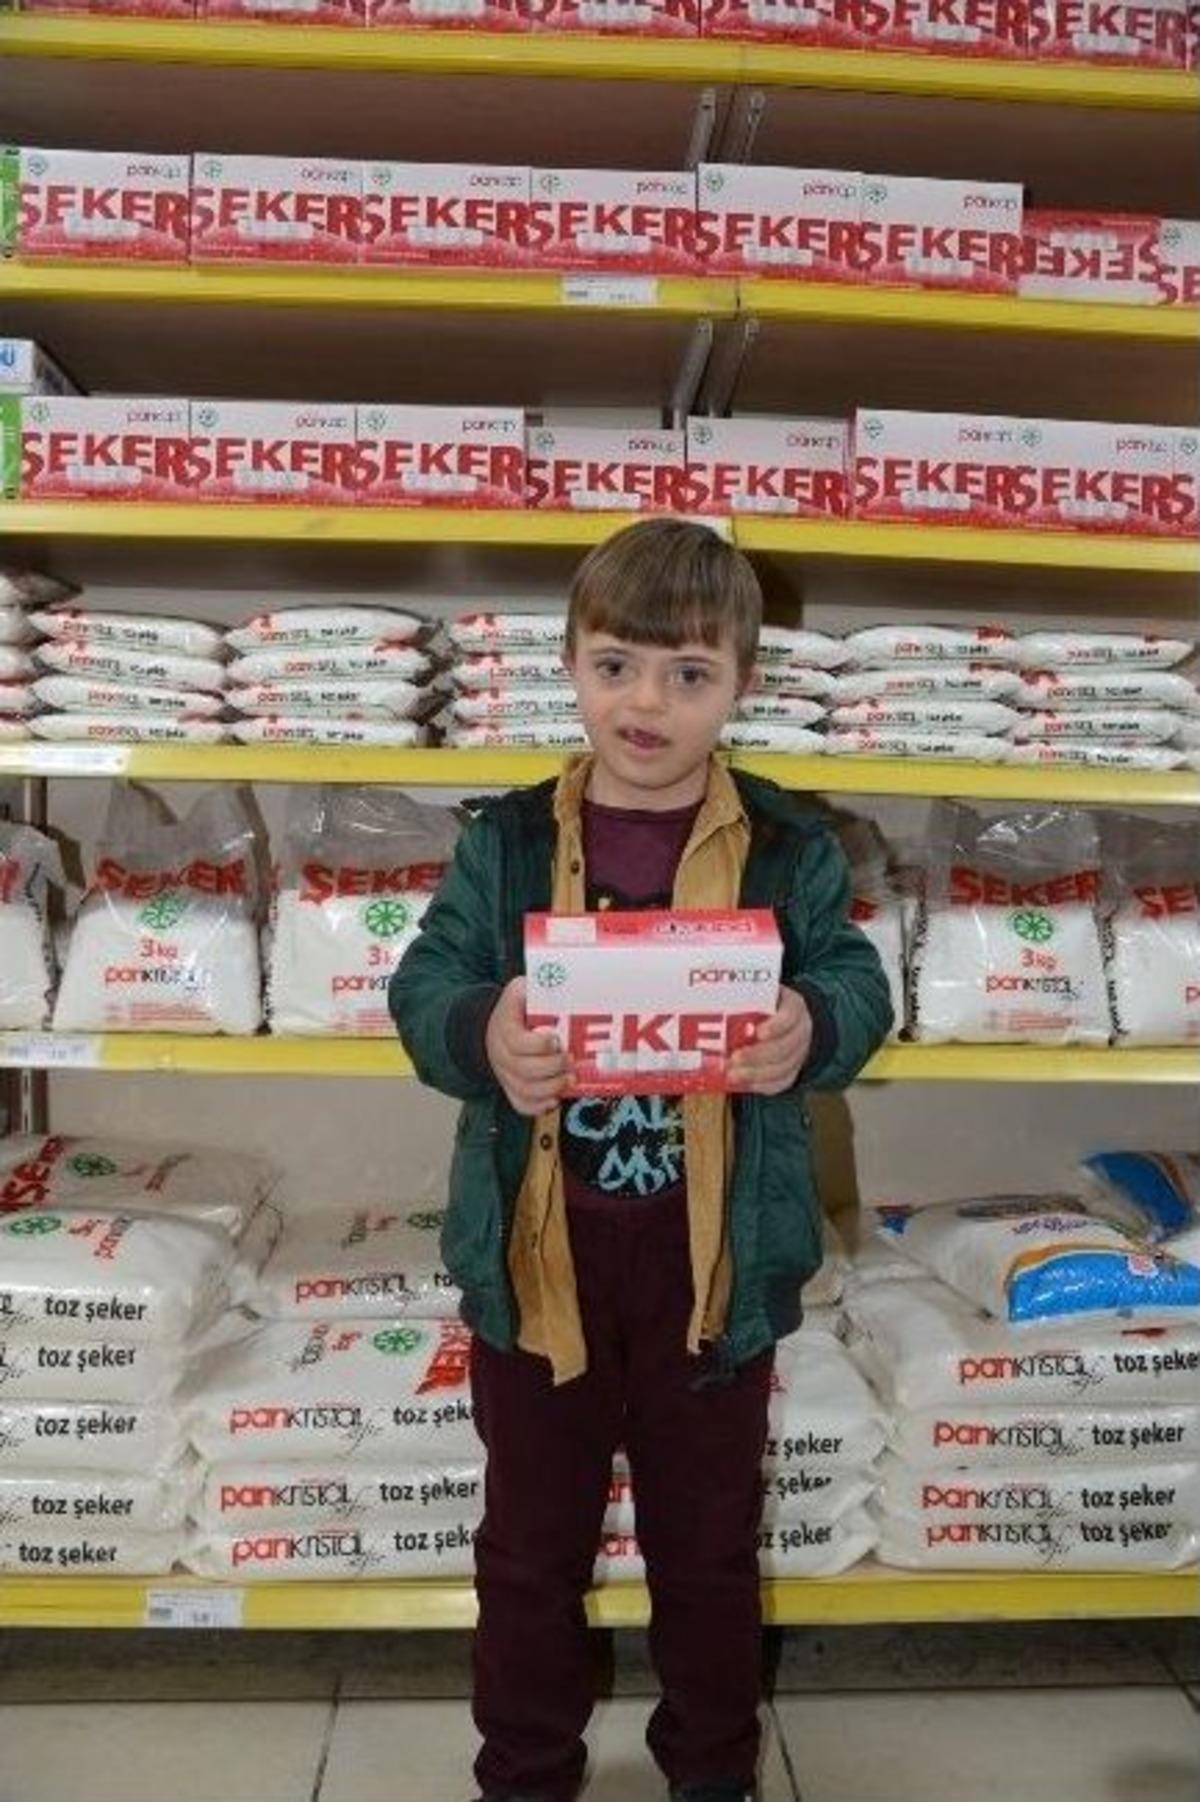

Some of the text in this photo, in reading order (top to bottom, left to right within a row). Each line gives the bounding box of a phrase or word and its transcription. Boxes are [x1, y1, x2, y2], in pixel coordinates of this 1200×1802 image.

[44, 1295, 147, 1322] toz şeker
[38, 1344, 136, 1373] toz şeker
[1114, 1352, 1148, 1374] toz
[35, 1410, 137, 1440] toz şeker
[393, 1405, 427, 1426] toz
[432, 1401, 473, 1428] şek
[783, 1430, 843, 1460] şeker
[1092, 1424, 1125, 1446] toz
[1130, 1421, 1186, 1451] şeker
[379, 1481, 413, 1502] toz
[420, 1476, 478, 1506] şeker
[1081, 1488, 1116, 1509] toz
[1119, 1483, 1176, 1512] şeker
[32, 1493, 134, 1520] toz şeker
[393, 1532, 428, 1552] toz
[434, 1523, 474, 1556] şek
[779, 1521, 832, 1553] şeker
[1081, 1521, 1116, 1543] toz
[18, 1540, 118, 1567] toz şeker
